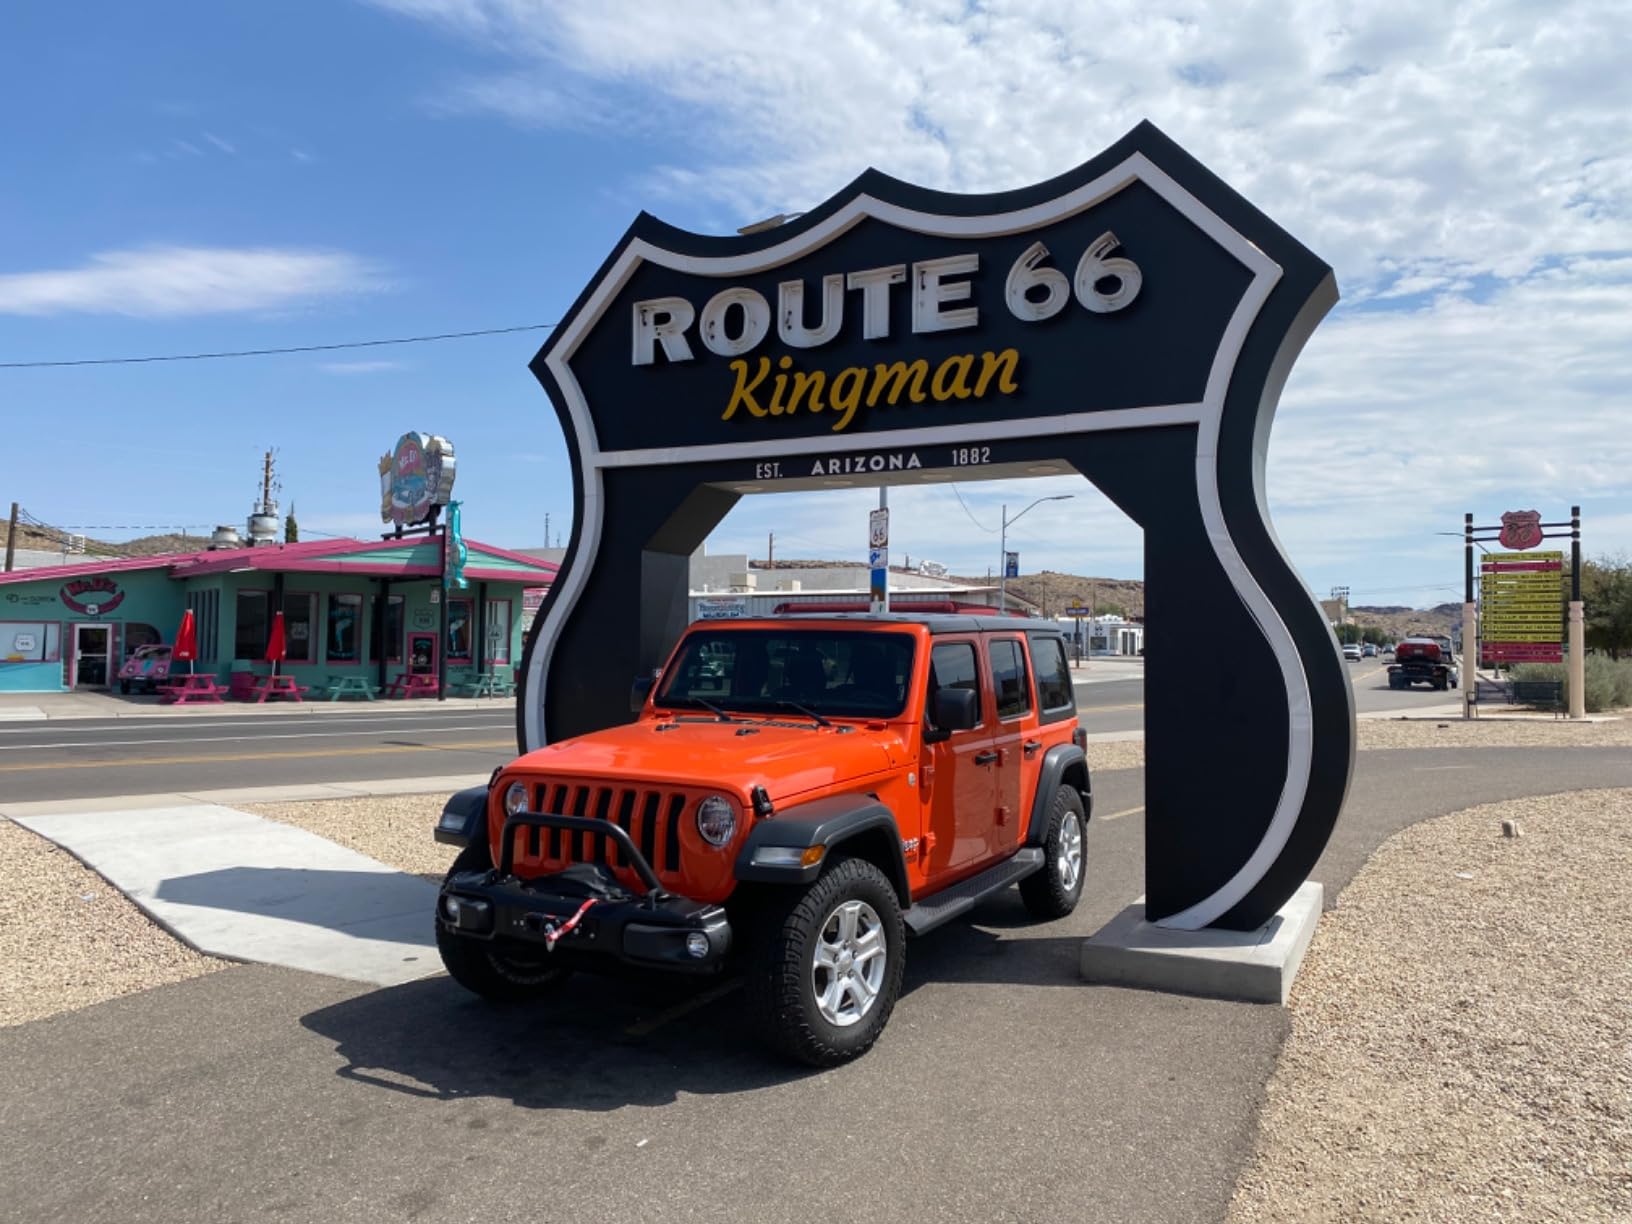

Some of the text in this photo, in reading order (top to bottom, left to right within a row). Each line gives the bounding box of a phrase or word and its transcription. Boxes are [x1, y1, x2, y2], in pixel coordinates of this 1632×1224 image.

[631, 230, 1143, 366] ROUTE 66
[721, 347, 1019, 432] Kingman
[756, 447, 991, 479] EST. ARIZONA 1882
[873, 526, 885, 542] 66
